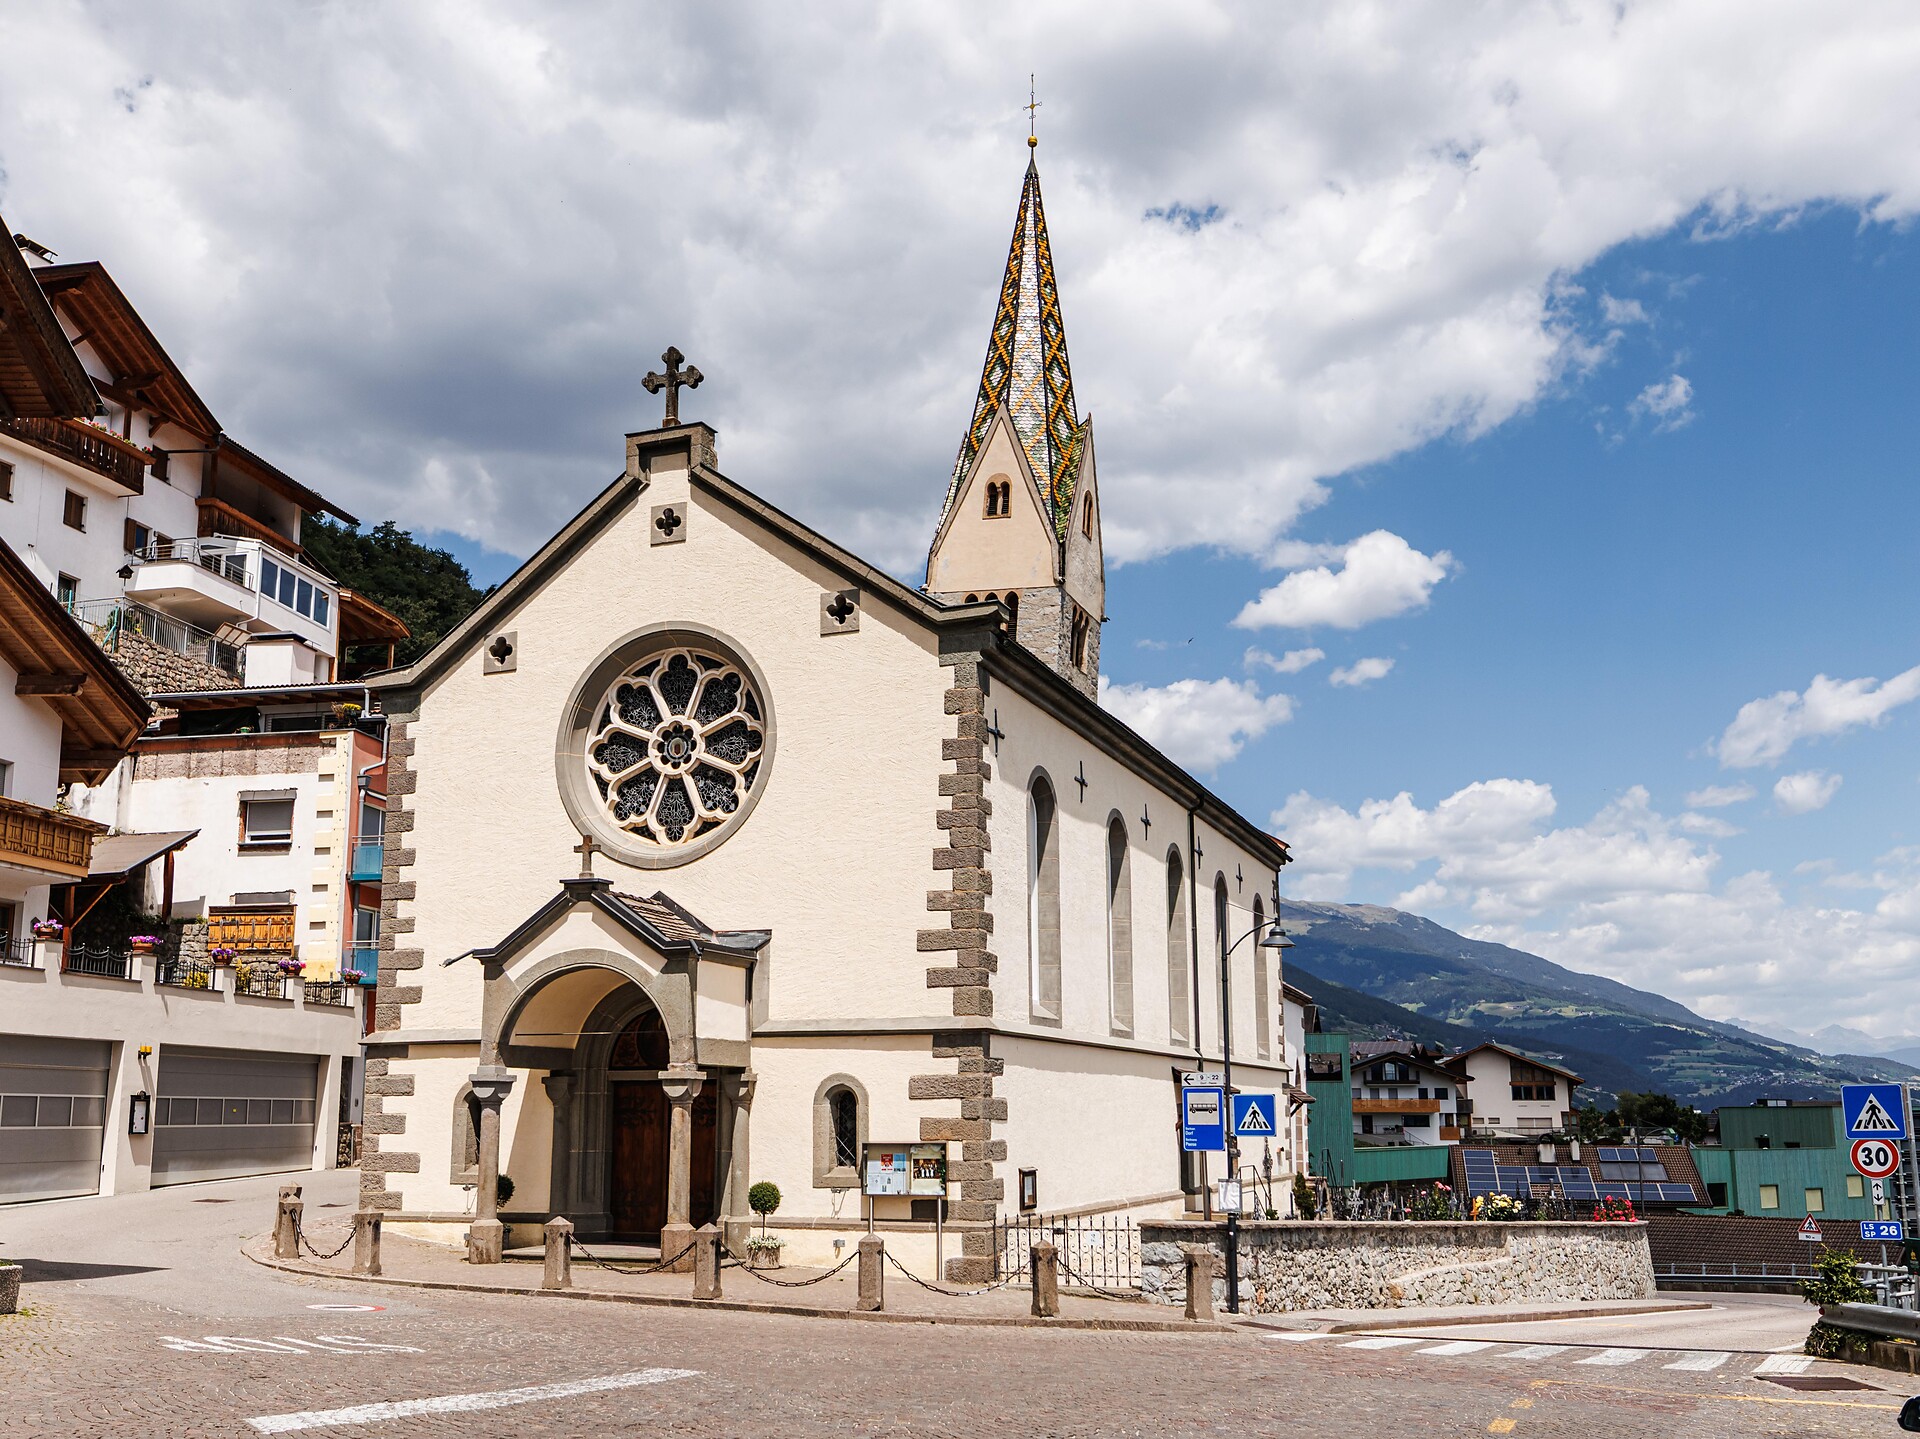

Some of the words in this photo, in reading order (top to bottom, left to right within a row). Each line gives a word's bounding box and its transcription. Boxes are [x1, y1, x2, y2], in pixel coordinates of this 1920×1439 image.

[1861, 1146, 1889, 1166] 30
[1880, 1226, 1898, 1236] 26
[159, 1335, 426, 1355] STOP
